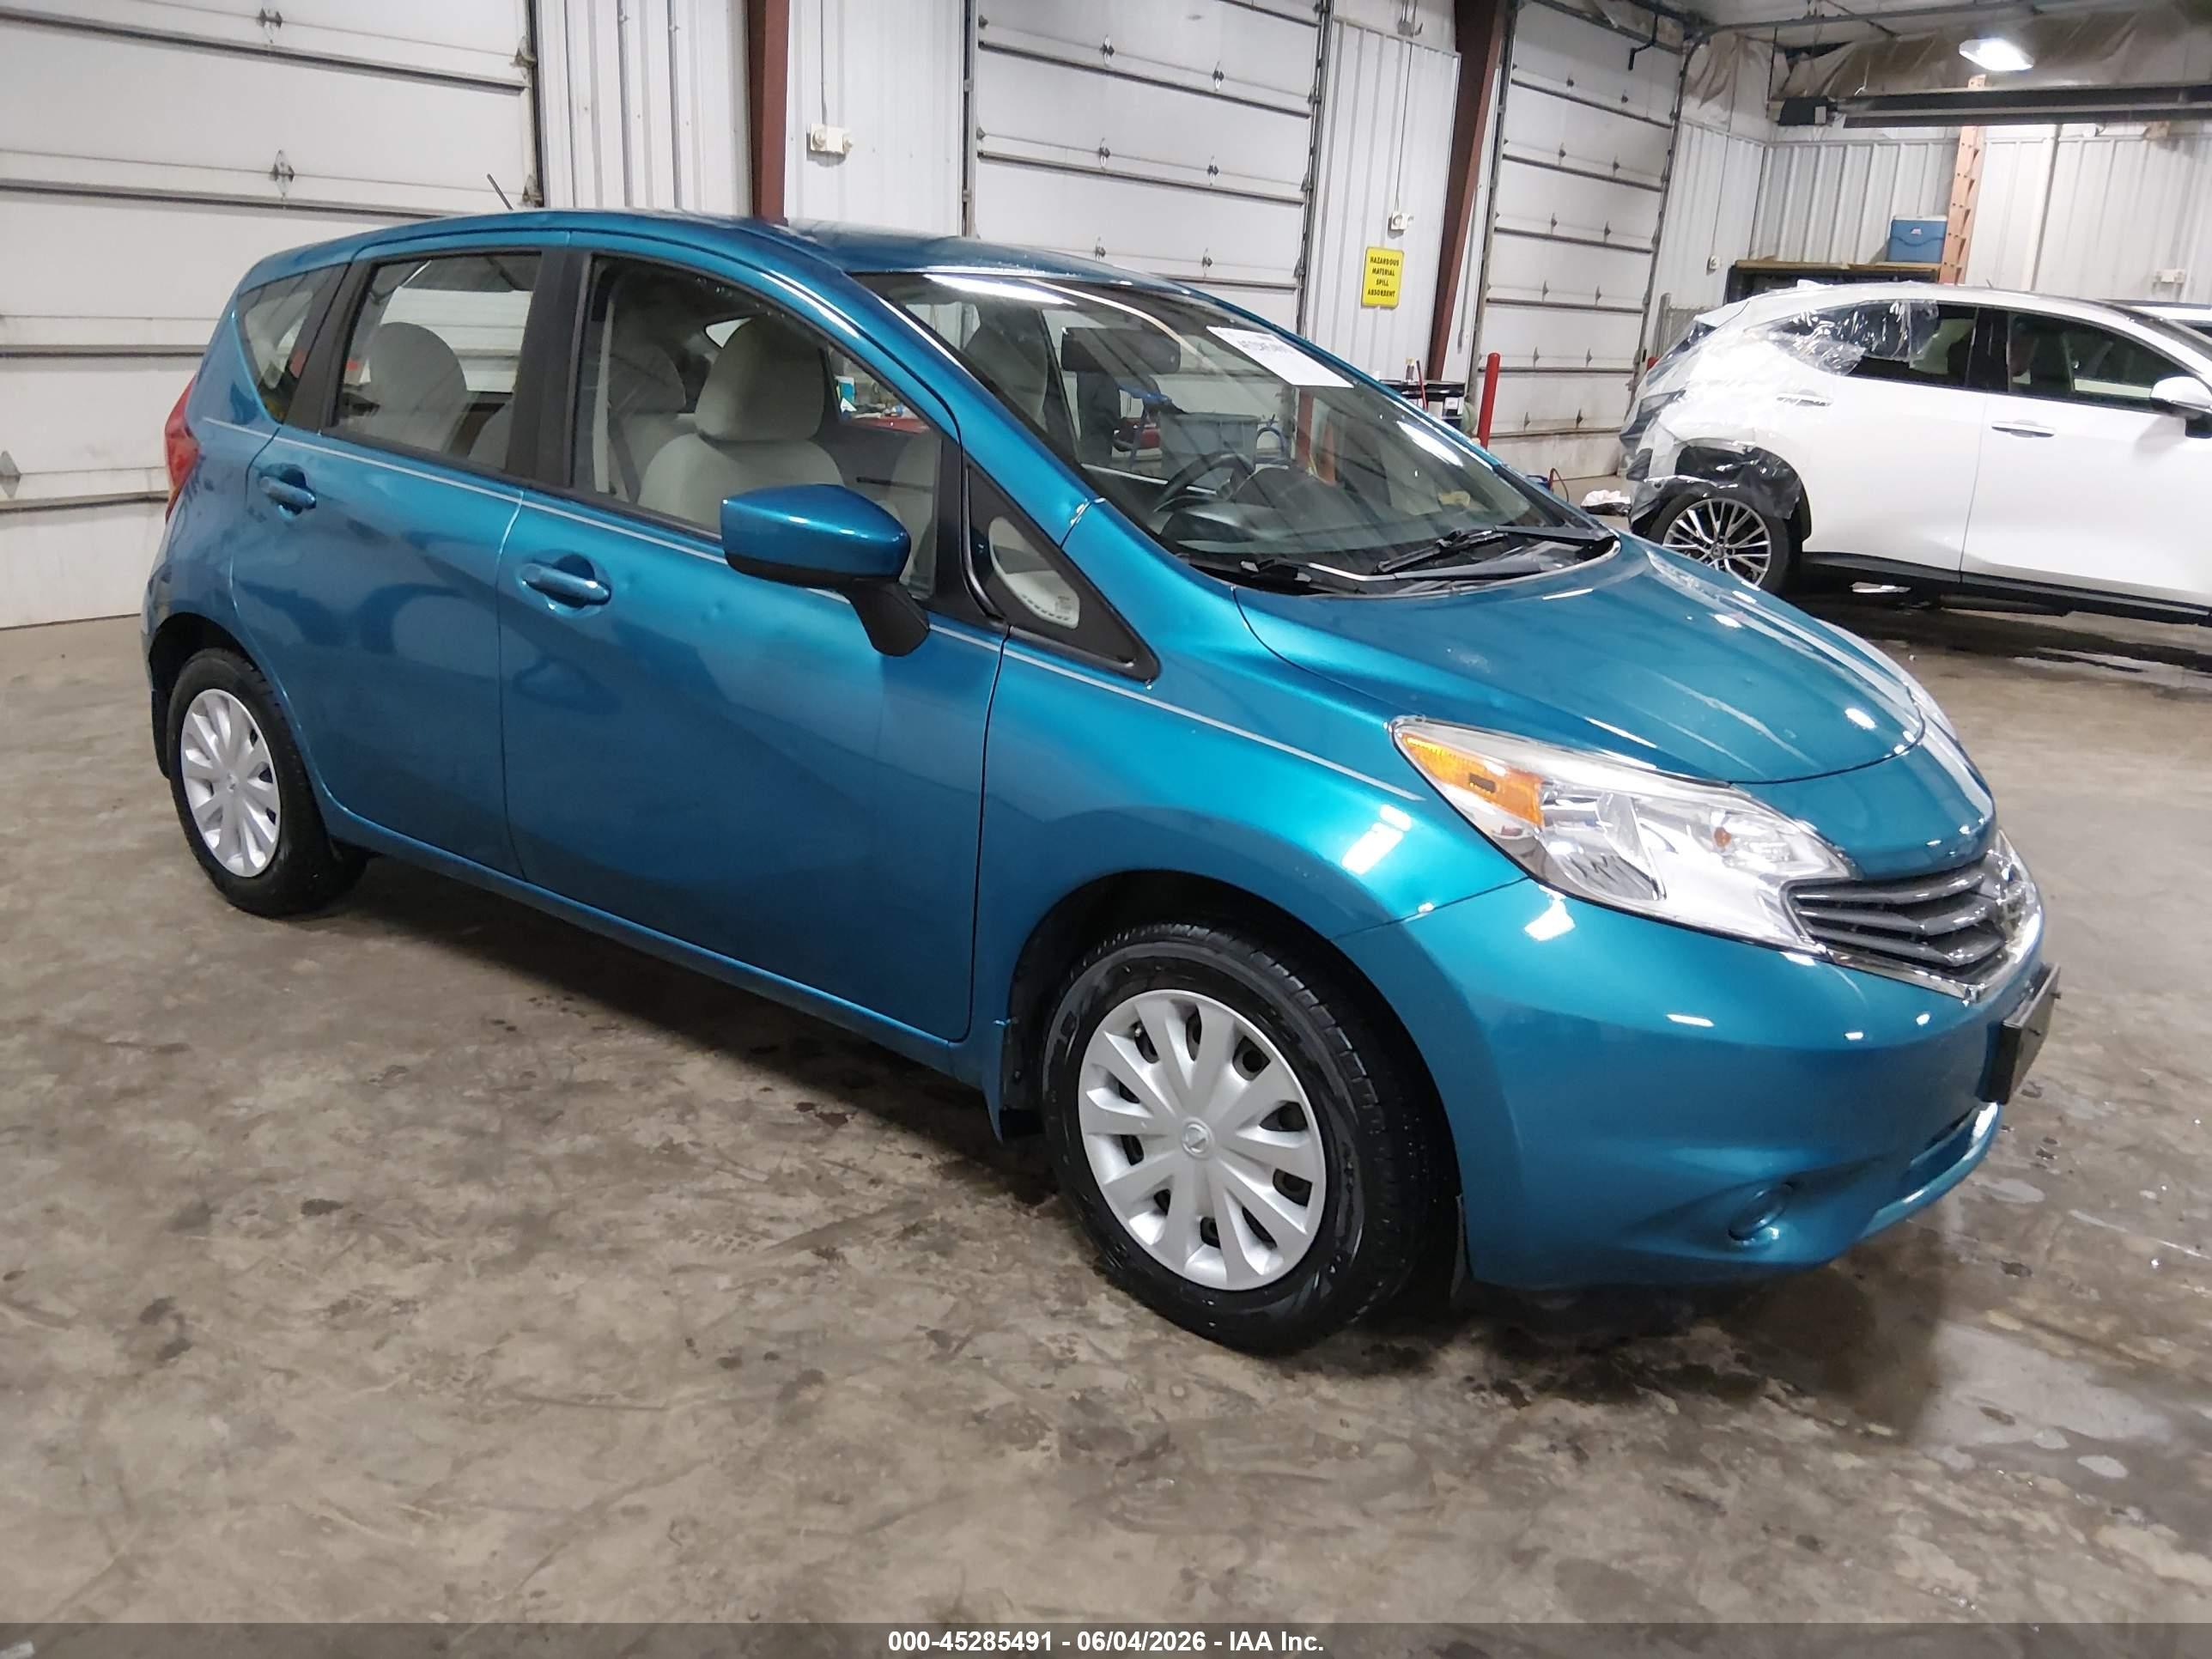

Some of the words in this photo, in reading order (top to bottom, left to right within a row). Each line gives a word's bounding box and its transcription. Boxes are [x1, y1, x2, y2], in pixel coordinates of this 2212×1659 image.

[1370, 257, 1400, 266] HAZARDOUS
[1371, 268, 1395, 276] MATERIAL
[1376, 278, 1389, 287] SPILL
[1367, 289, 1395, 297] ABSORBENT
